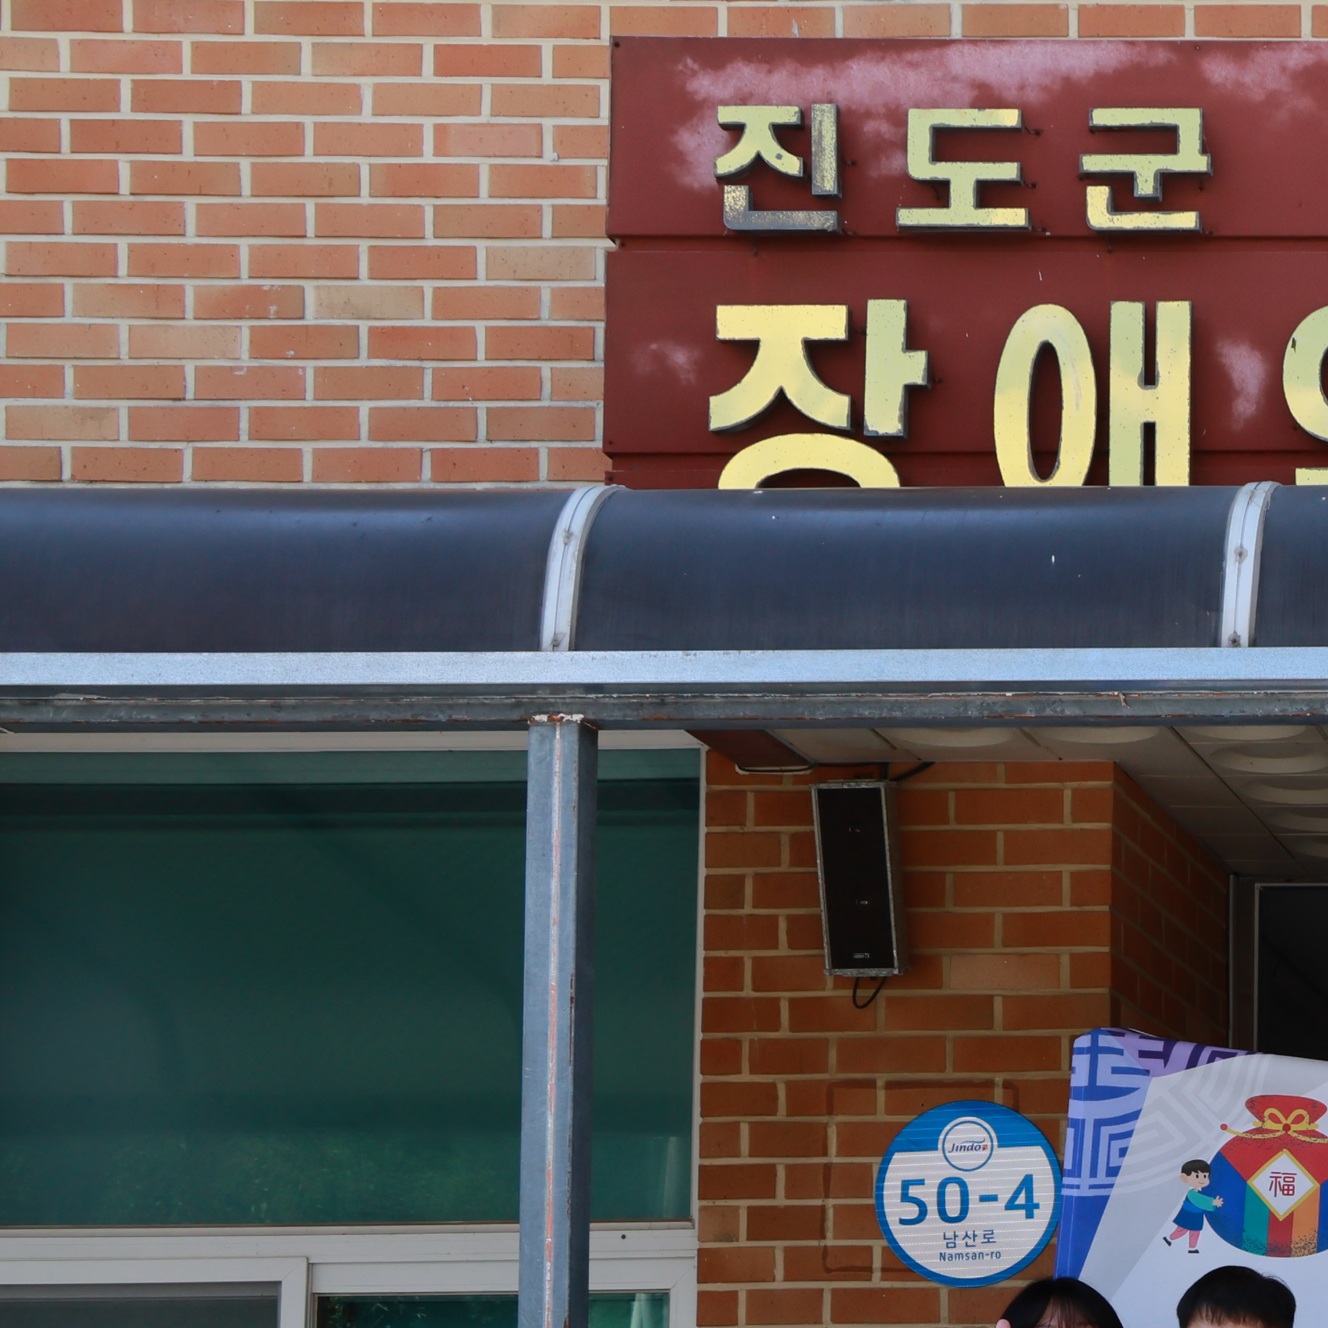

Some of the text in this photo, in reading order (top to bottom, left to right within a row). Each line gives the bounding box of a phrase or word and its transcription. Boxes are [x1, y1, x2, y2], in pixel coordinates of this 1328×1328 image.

[713, 103, 1212, 232] 진도군
[948, 1142, 981, 1154] Jindo
[1268, 1170, 1296, 1197] 福
[899, 1174, 1040, 1226] 50-4
[943, 1229, 997, 1249] 남산로
[939, 1250, 1002, 1262] Namsan-ro
